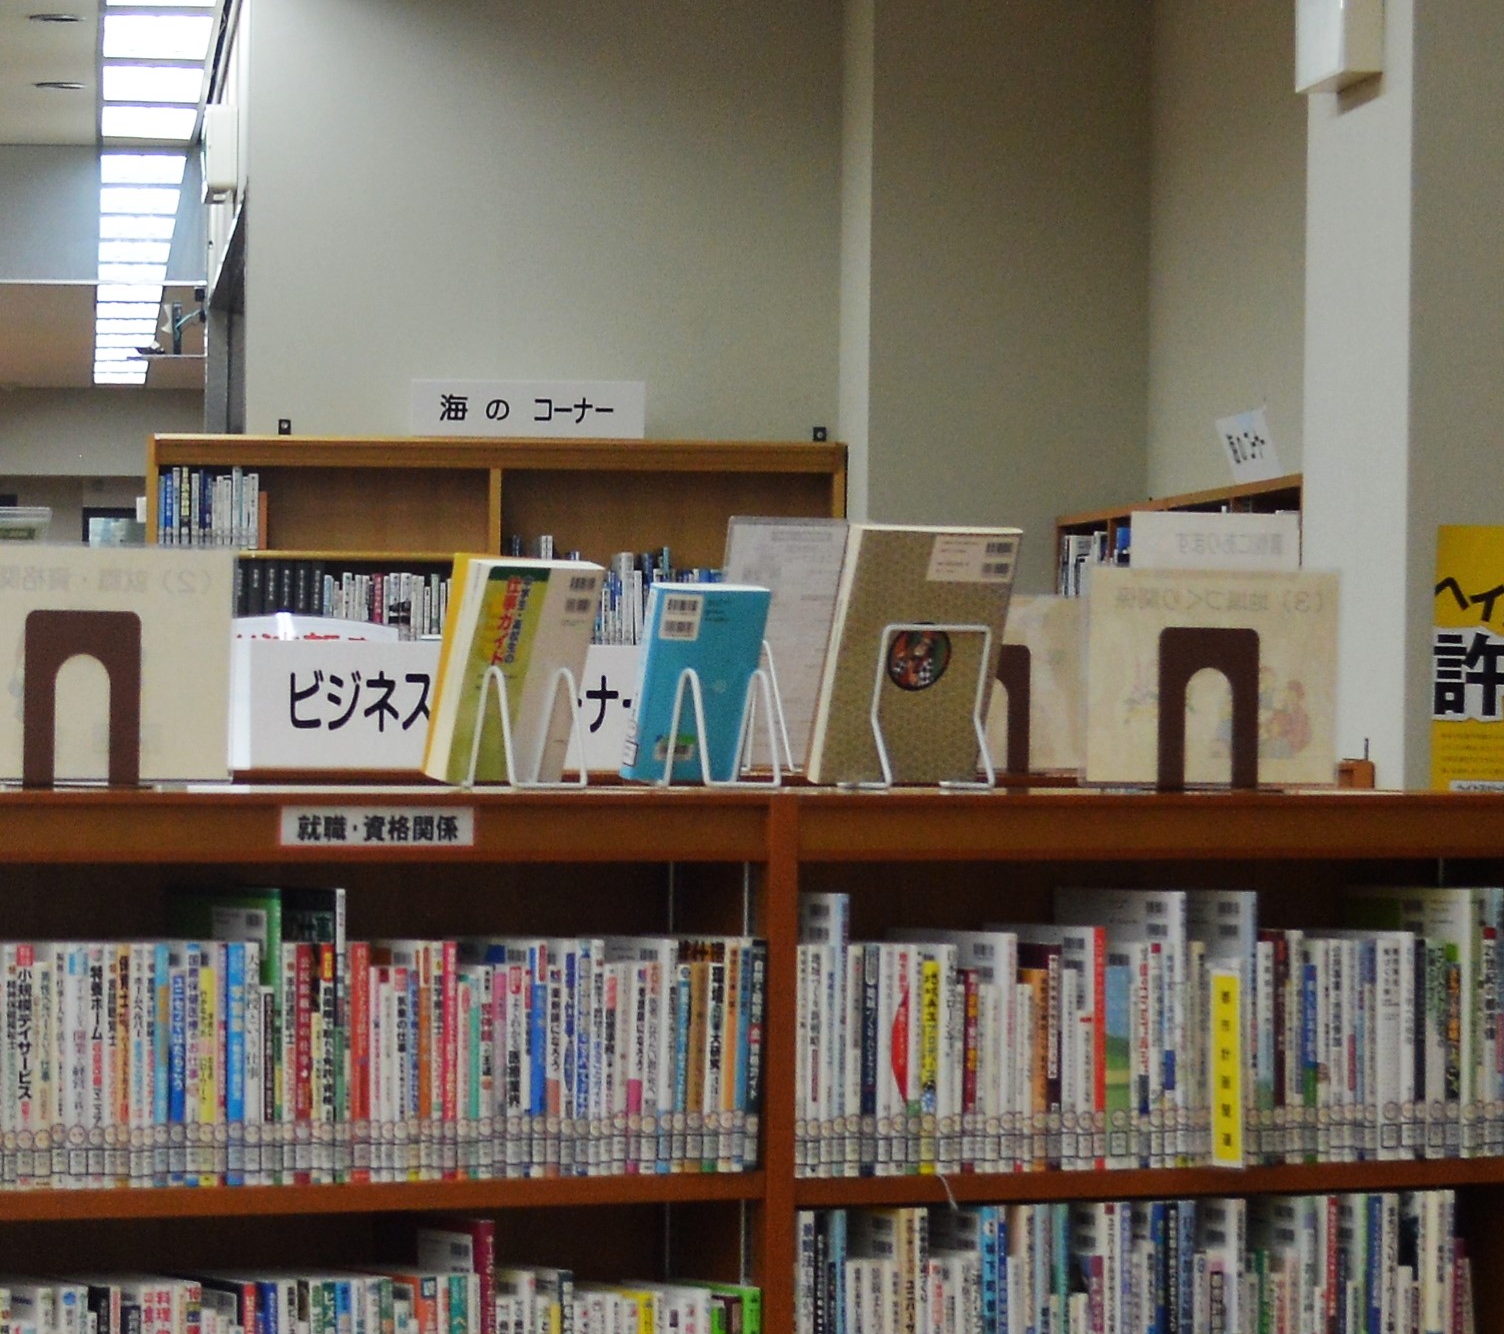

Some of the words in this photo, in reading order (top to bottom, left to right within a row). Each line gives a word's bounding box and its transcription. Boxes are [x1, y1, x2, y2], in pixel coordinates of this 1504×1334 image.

[296, 814, 459, 844] 就職・資格関係
[17, 968, 34, 1100] 小規模デイサービス
[90, 965, 104, 1041] 特養ホーム
